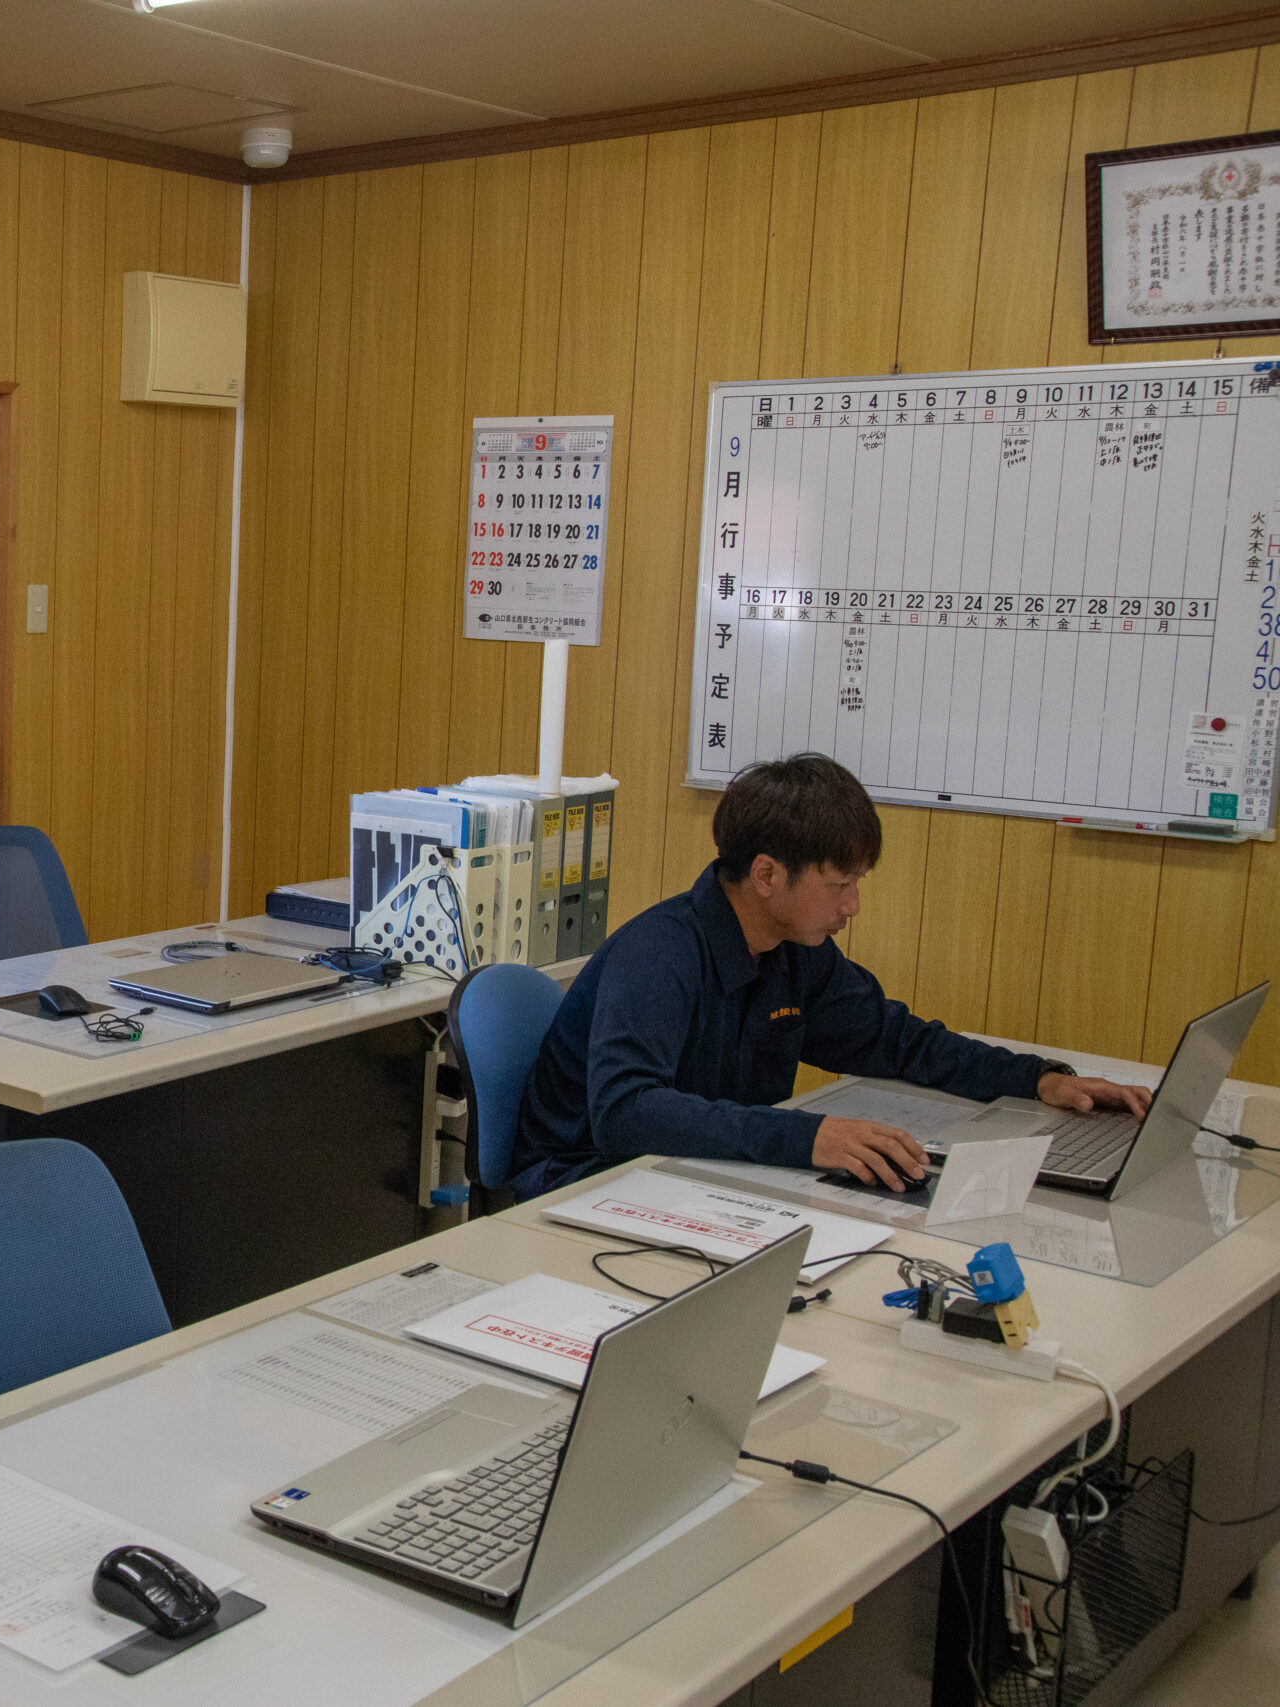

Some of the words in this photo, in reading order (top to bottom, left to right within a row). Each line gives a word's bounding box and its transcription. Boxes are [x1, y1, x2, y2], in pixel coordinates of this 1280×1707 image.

[760, 398, 772, 412] 日
[789, 397, 794, 411] 1
[814, 396, 823, 410] 2
[841, 395, 851, 409] 3
[869, 394, 878, 408] 4
[897, 393, 907, 407] 5
[926, 392, 936, 406] 6
[956, 391, 966, 405] 7
[986, 390, 996, 404] 8
[1016, 389, 1027, 403] 9
[1045, 387, 1063, 402] 10
[1079, 386, 1093, 401] 11
[1110, 384, 1128, 400] 12
[1144, 383, 1163, 399] 13
[1178, 381, 1196, 397] 14
[1214, 379, 1233, 396] 15
[757, 415, 772, 427] 曜
[786, 417, 794, 426] 日
[812, 415, 821, 425] 月
[840, 414, 849, 425] 火
[867, 413, 878, 424] 水
[896, 412, 907, 423] 木
[924, 412, 935, 424] 金
[953, 410, 965, 421] 土
[985, 410, 993, 420] 日
[1016, 408, 1025, 419] 月
[1046, 407, 1057, 418] 火
[1078, 406, 1090, 418] 水
[1110, 404, 1124, 417] 木
[1144, 403, 1158, 416] 金
[1180, 402, 1193, 414] 土
[1216, 401, 1227, 412] 日
[535, 434, 547, 450] 9
[482, 465, 485, 478] 1
[498, 464, 505, 479] 2
[517, 464, 523, 479] 3
[535, 465, 542, 479] 4
[554, 464, 561, 479] 5
[573, 464, 580, 479] 6
[593, 464, 600, 479] 7
[478, 494, 485, 508] 8
[496, 494, 503, 508] 9
[512, 494, 525, 508] 10
[531, 494, 543, 508] 11
[549, 494, 562, 509] 12
[568, 494, 582, 509] 13
[588, 495, 601, 509] 14
[474, 523, 486, 536] 15
[492, 523, 504, 537] 16
[510, 523, 523, 537] 17
[529, 524, 541, 538] 18
[547, 524, 560, 538] 19
[566, 524, 580, 539] 20
[586, 525, 599, 539] 21
[472, 552, 485, 565] 22
[490, 552, 503, 566] 23
[508, 553, 521, 567] 24
[526, 553, 540, 567] 25
[545, 554, 559, 568] 26
[563, 554, 578, 569] 27
[583, 555, 597, 570] 28
[1266, 559, 1273, 581] 1
[470, 580, 484, 594] 29
[488, 581, 502, 595] 30
[1261, 586, 1276, 609] 2
[747, 589, 760, 603] 16
[773, 590, 787, 603] 17
[799, 591, 813, 605] 18
[825, 592, 839, 606] 19
[850, 593, 867, 606] 20
[878, 593, 894, 608] 21
[906, 594, 924, 608] 22
[935, 595, 953, 609] 23
[964, 596, 982, 610] 24
[994, 596, 1013, 611] 25
[1025, 597, 1044, 612] 26
[1056, 598, 1076, 613] 27
[1088, 599, 1107, 614] 28
[1120, 600, 1141, 615] 29
[1154, 601, 1175, 616] 30
[1188, 602, 1209, 617] 31
[749, 607, 756, 617] 月
[773, 608, 784, 619] 火
[799, 609, 810, 619] 水
[826, 610, 836, 620] 木
[851, 611, 864, 623] 金
[879, 612, 892, 624] 土
[910, 614, 918, 623] 日
[938, 613, 947, 625] 月
[966, 615, 977, 626] 火
[995, 616, 1007, 627] 水
[1027, 616, 1039, 628] 木
[1057, 618, 1069, 629] 金
[1089, 619, 1101, 630] 土
[1123, 620, 1133, 630] 日
[1158, 621, 1168, 632] 月
[1256, 640, 1269, 662] 4
